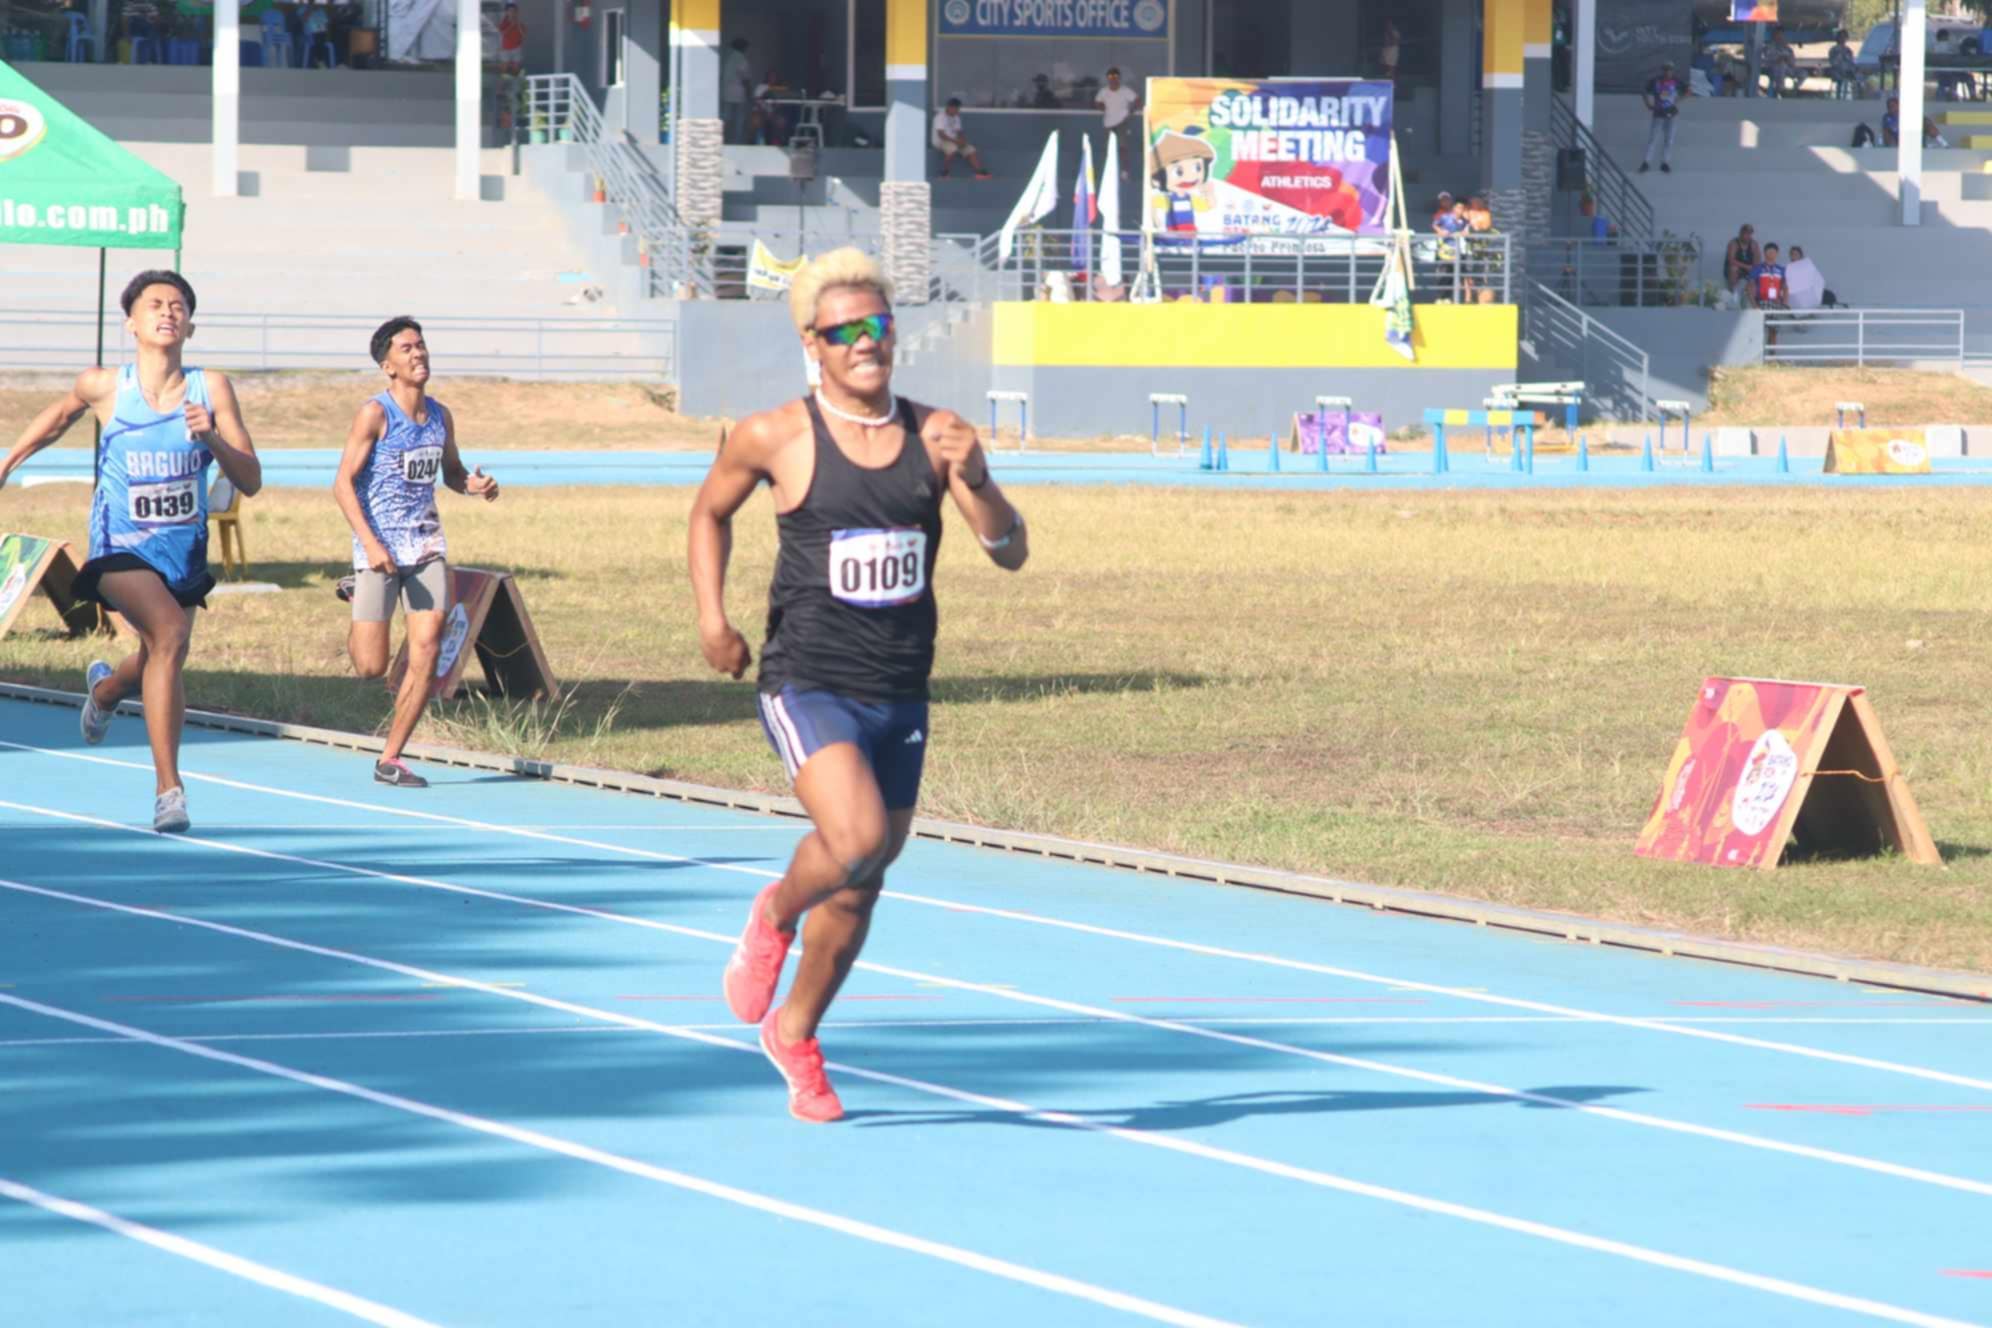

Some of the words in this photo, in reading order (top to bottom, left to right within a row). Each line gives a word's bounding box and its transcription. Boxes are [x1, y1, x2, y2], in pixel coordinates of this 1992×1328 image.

[976, 0, 1010, 26] CITY
[1013, 0, 1073, 27] SPORTS
[1076, 0, 1129, 28] OFFICE
[1209, 95, 1387, 127] SOLIDARITY
[1230, 129, 1366, 161] MEETING
[1261, 175, 1333, 189] ATHLETICS
[1271, 240, 1326, 253] Prinesa
[126, 449, 202, 478] BAGUIO
[135, 491, 194, 518] 0139
[841, 552, 917, 592] 0109
